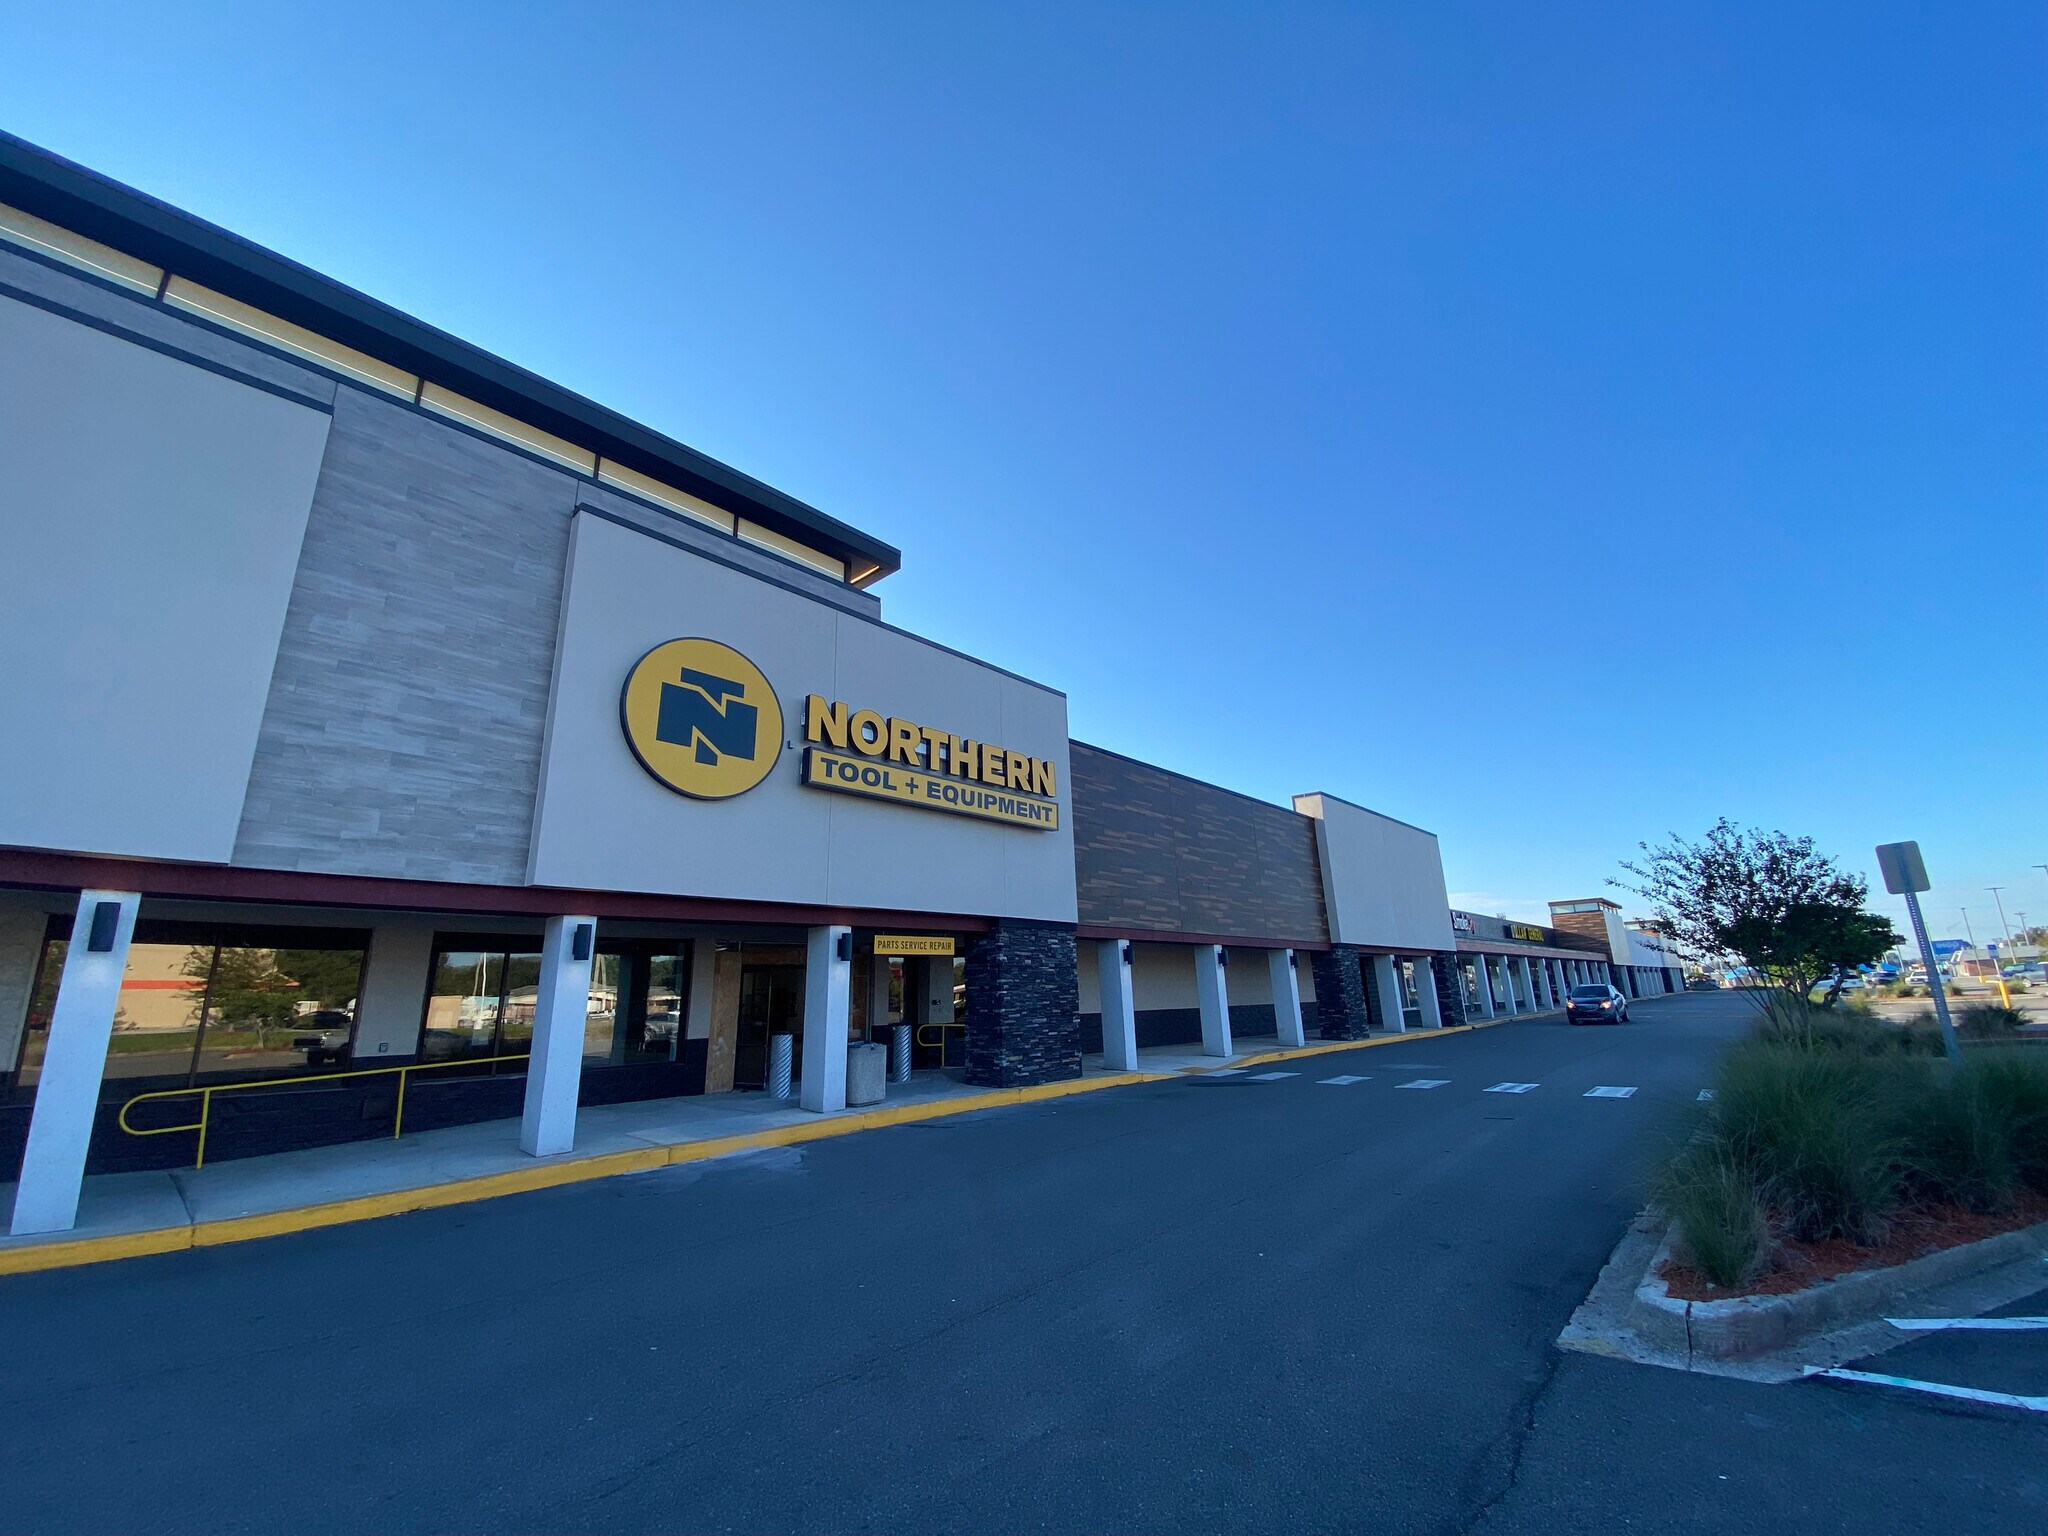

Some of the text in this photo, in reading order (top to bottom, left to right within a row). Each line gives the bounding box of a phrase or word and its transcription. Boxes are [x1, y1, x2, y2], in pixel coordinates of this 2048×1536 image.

[805, 694, 1056, 797] NORTHERN
[820, 757, 897, 791] TOOL
[926, 780, 1053, 822] EQUIPMENT
[877, 940, 952, 950] PARTS SERVICE REPAIR
